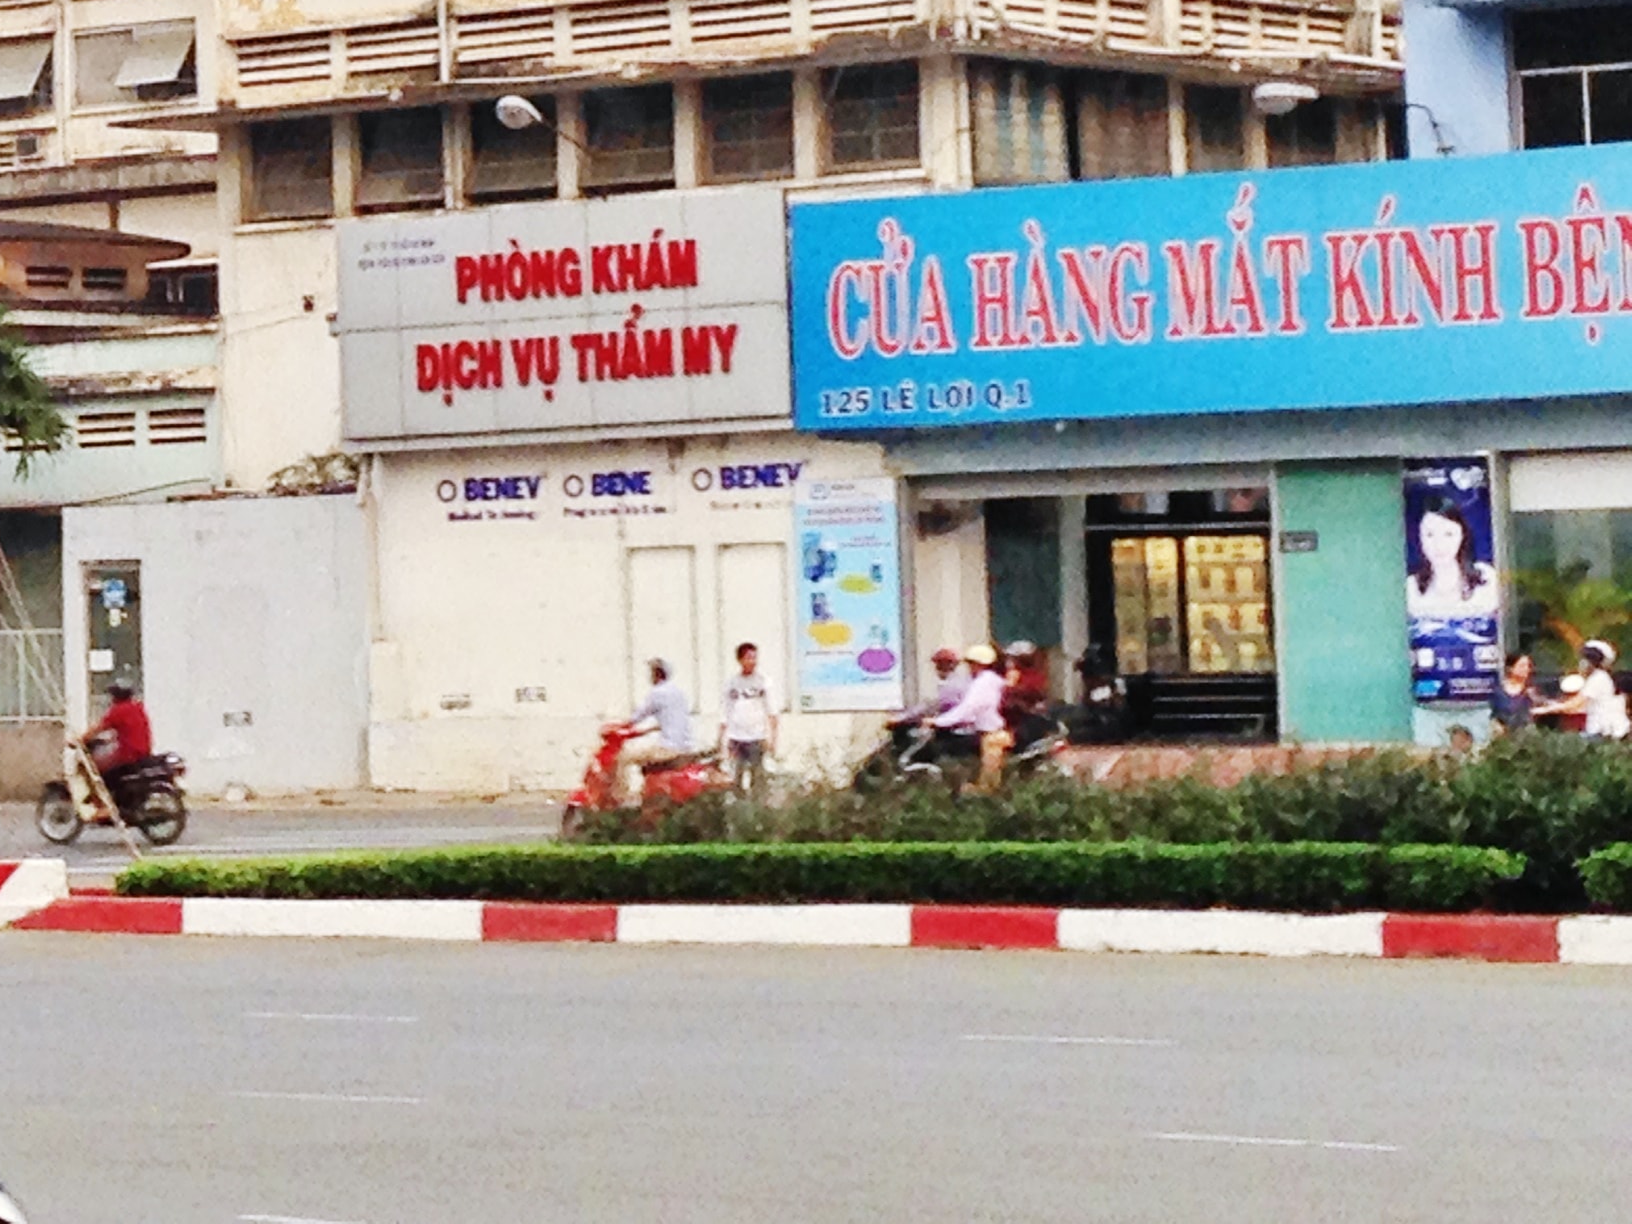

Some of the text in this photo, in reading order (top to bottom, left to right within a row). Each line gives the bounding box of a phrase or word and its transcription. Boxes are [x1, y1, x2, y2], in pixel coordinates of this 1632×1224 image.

[455, 228, 699, 305] PHÒNG KHÁM
[826, 218, 957, 360] CỬA
[968, 218, 1153, 351] HÀNG
[1165, 181, 1309, 341] MẮT
[1325, 194, 1504, 332] KÍNH
[416, 339, 503, 407] DỊCH
[511, 336, 560, 403] VỤ
[571, 303, 674, 382] THẨM
[822, 389, 870, 414] 125
[881, 380, 914, 412] LÊ
[464, 476, 541, 501] BENEV
[720, 462, 803, 490] BENEV
